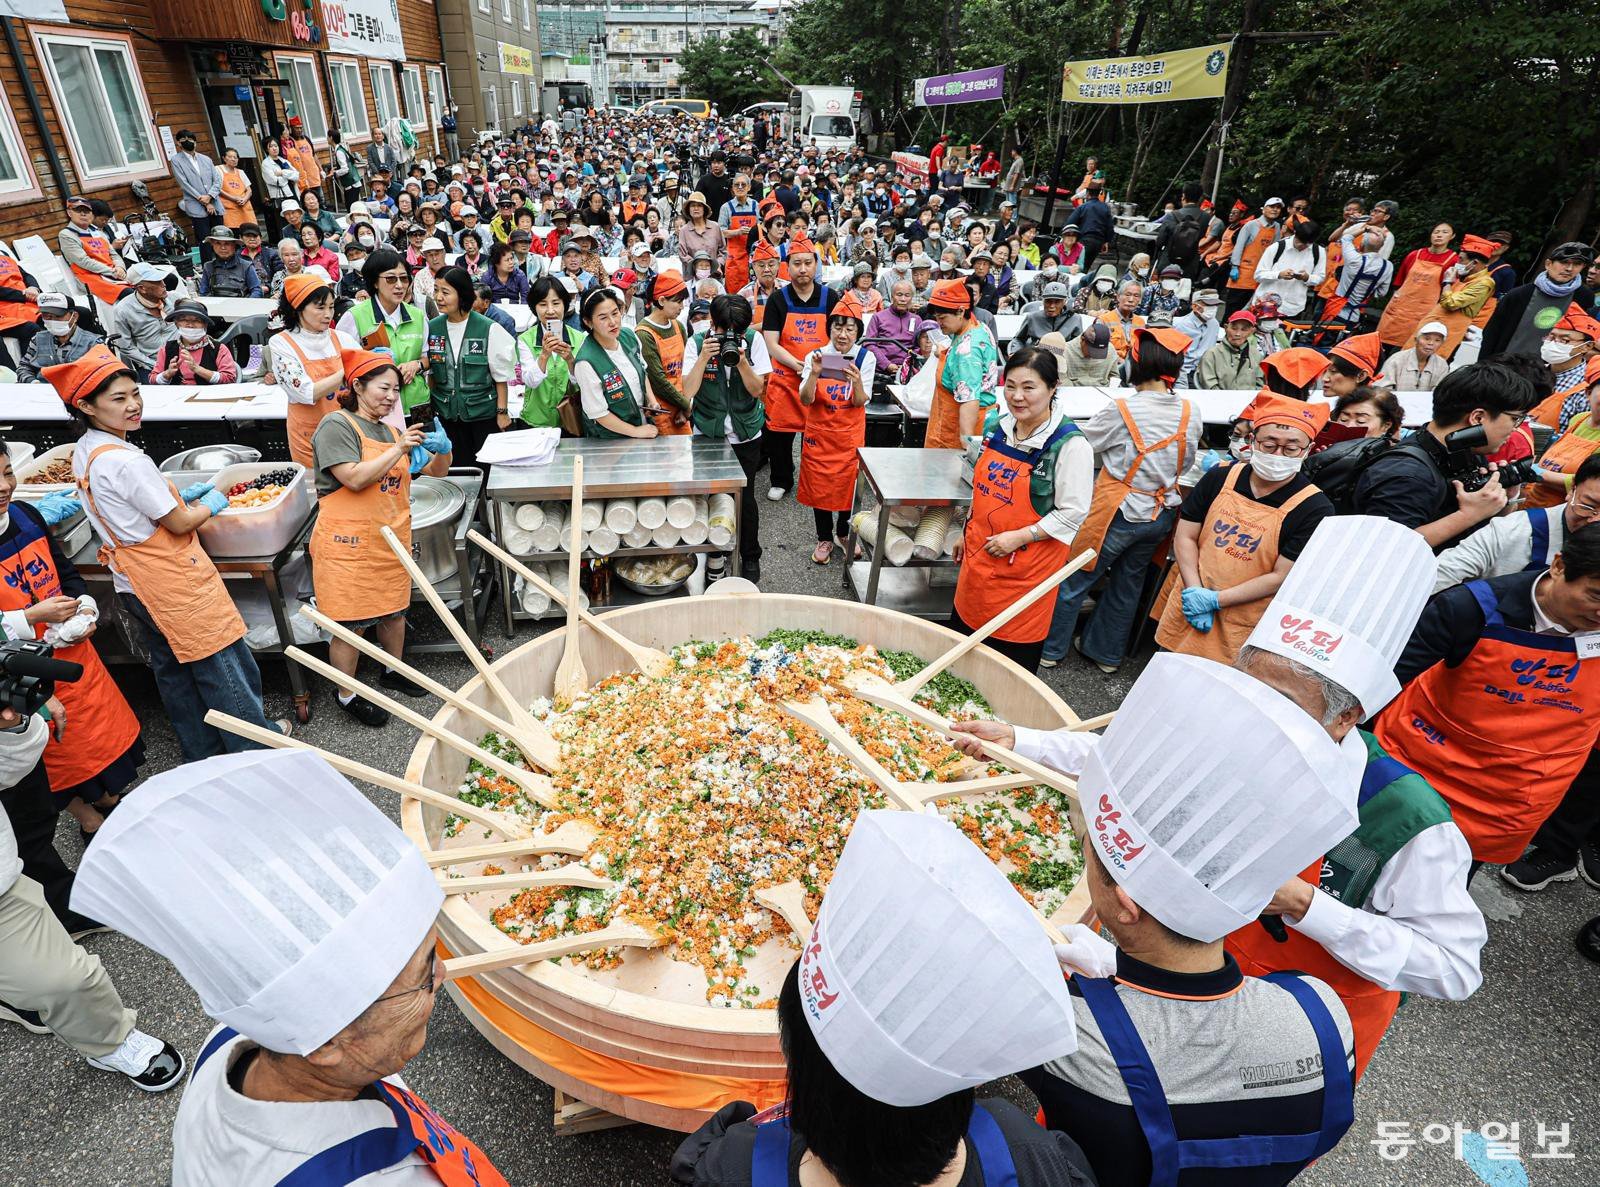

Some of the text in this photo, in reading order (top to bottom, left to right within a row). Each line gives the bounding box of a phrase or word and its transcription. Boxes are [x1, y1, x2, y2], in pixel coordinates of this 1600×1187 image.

[349, 13, 366, 41] 그릇
[1086, 61, 1165, 80] 이제는 생존에서 존엄으로!
[1125, 81, 1172, 96] 지켜주세요!!
[616, 272, 624, 280] N
[795, 319, 817, 333] 밥퍼
[988, 460, 1018, 483] 밥퍼
[1213, 519, 1263, 553] 밥퍼
[1224, 546, 1253, 561] Babfor
[4, 551, 49, 594] 밥퍼
[1280, 614, 1344, 654] 밥퍼
[1293, 640, 1330, 662] Babfor
[1510, 658, 1581, 685] 밥퍼
[1533, 680, 1573, 694] Babfor
[1095, 794, 1147, 861] 밥퍼
[1099, 833, 1127, 870] Babfor
[804, 920, 840, 1010] 밥퍼
[802, 968, 821, 1020] Babfor
[1240, 1061, 1293, 1083] MULTI
